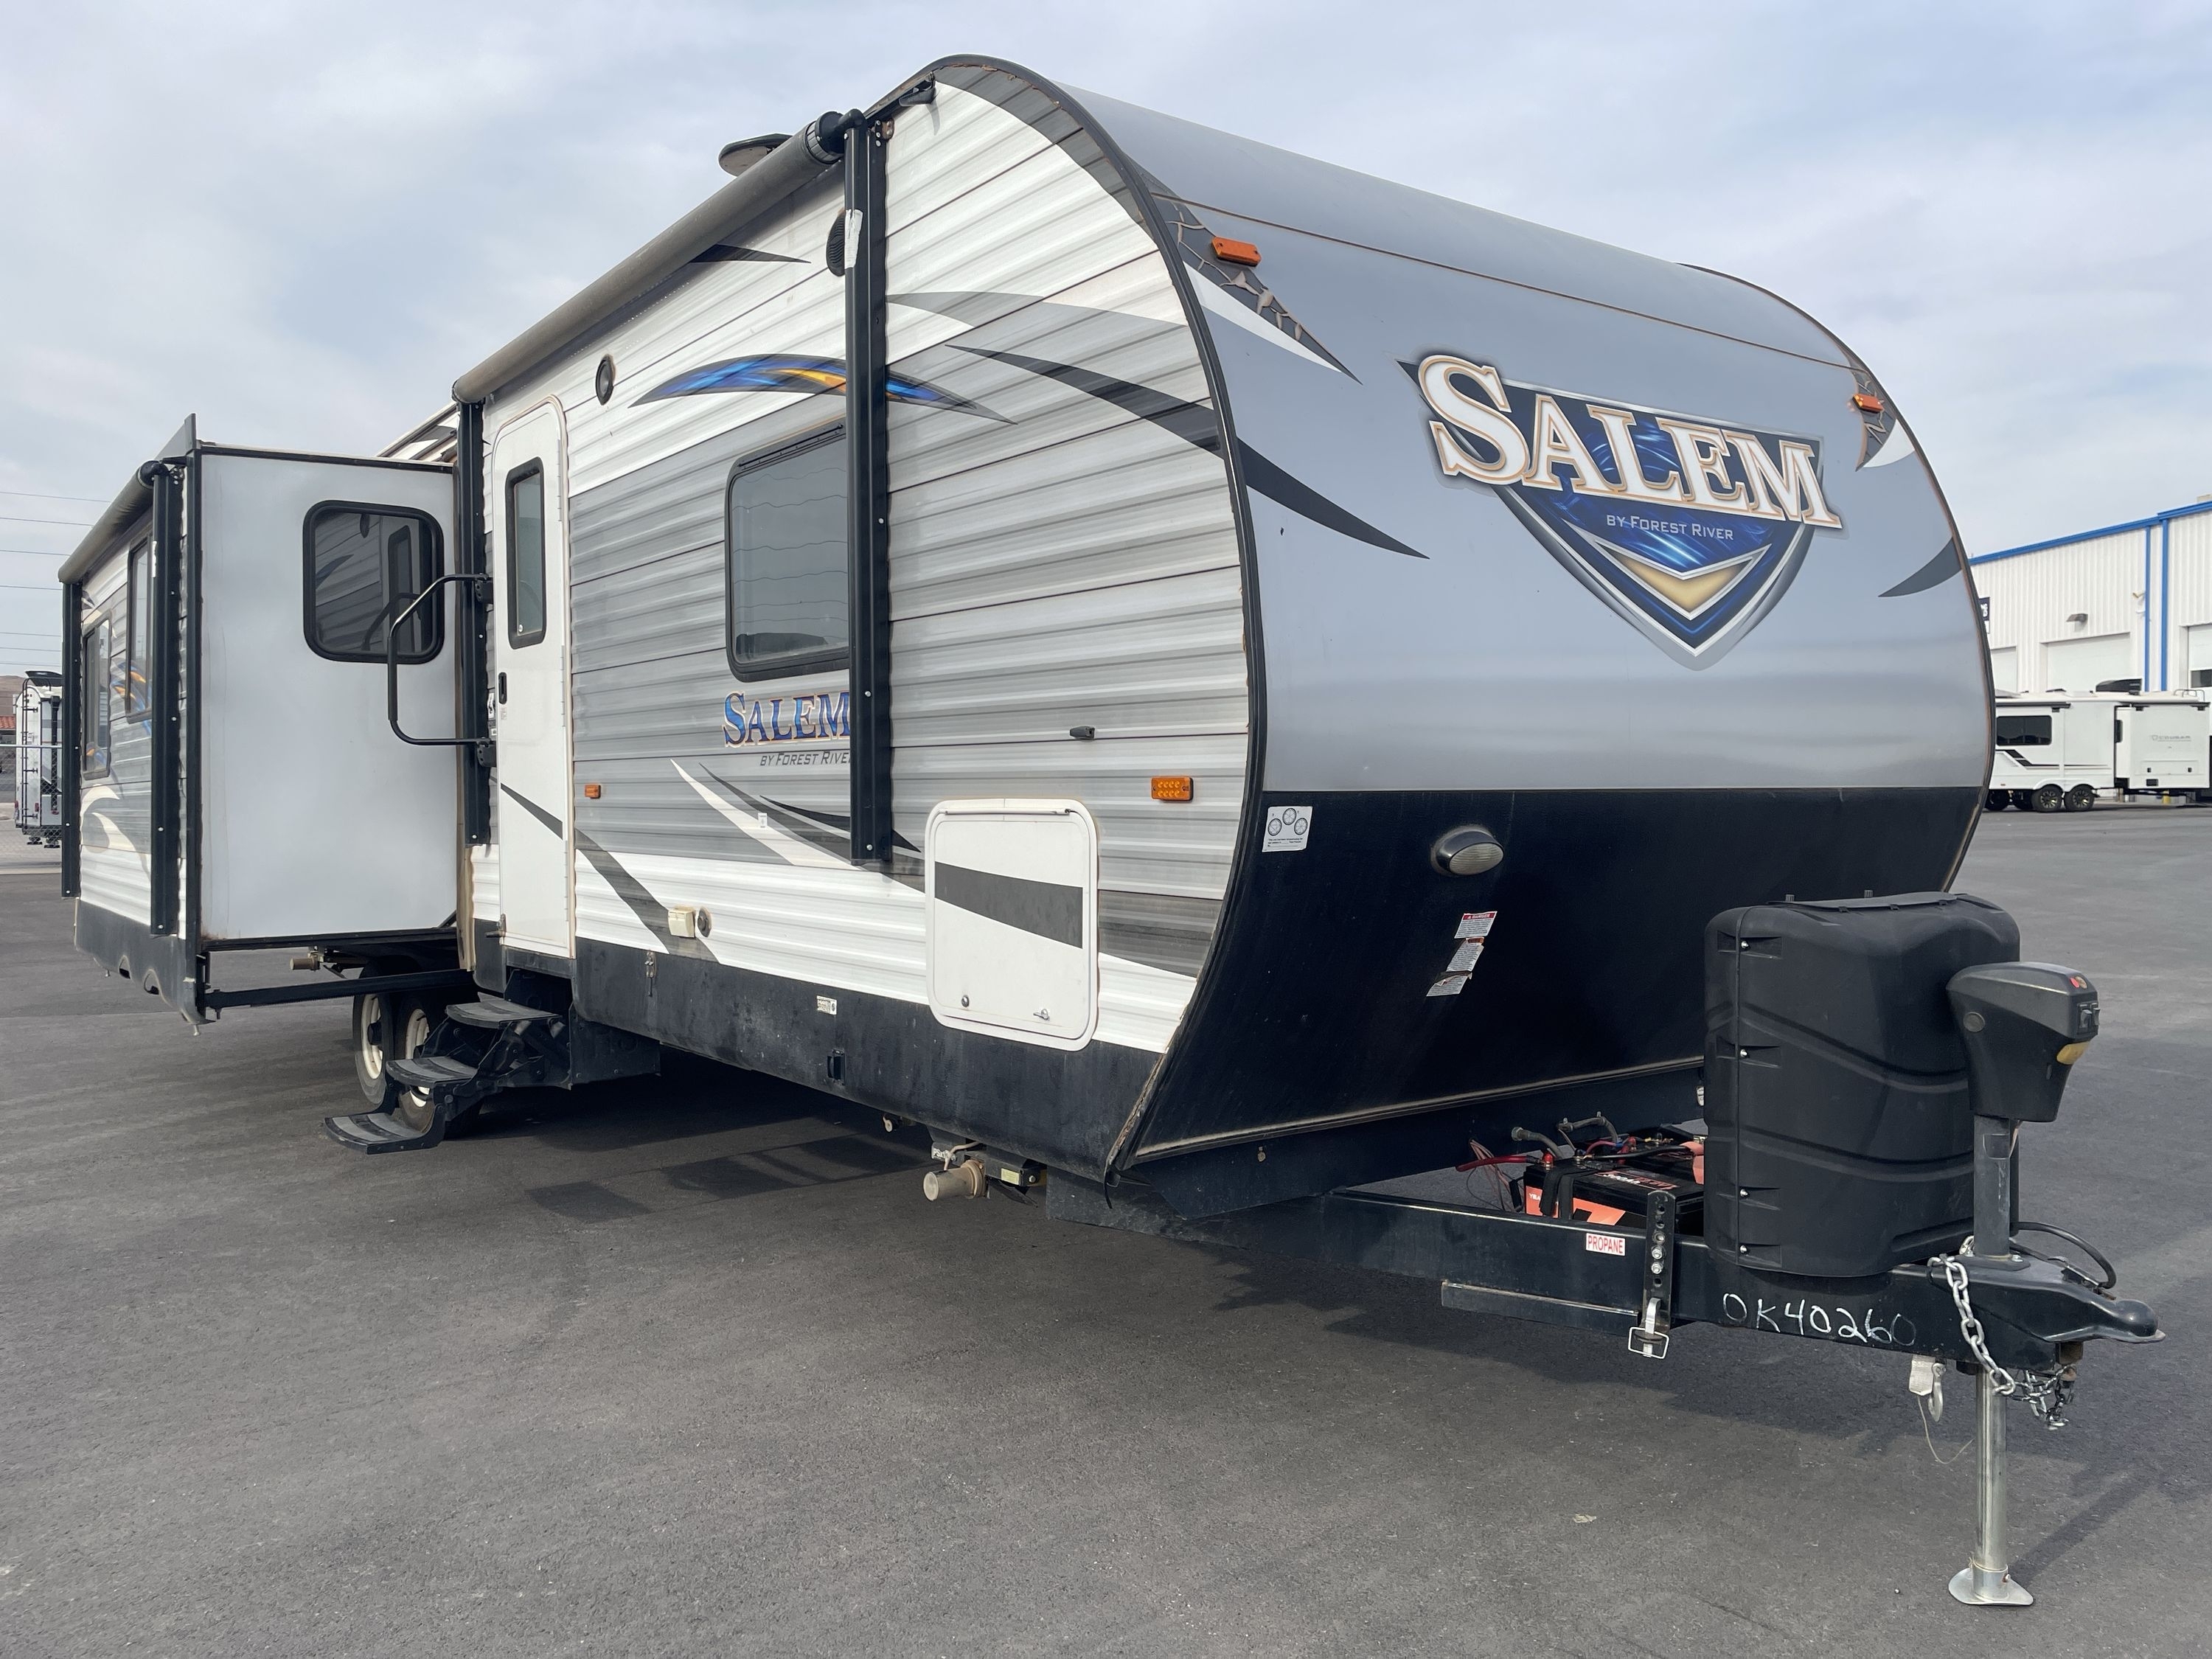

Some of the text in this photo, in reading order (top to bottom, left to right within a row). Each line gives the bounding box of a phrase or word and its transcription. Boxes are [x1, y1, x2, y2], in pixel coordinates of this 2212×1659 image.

[1418, 354, 1843, 529] SALEM
[1606, 514, 1734, 540] BY FOREST RIVER
[722, 690, 850, 748] SALEM
[760, 751, 850, 766] BY FOREST RIVE
[1587, 1235, 1624, 1254] PROPANE
